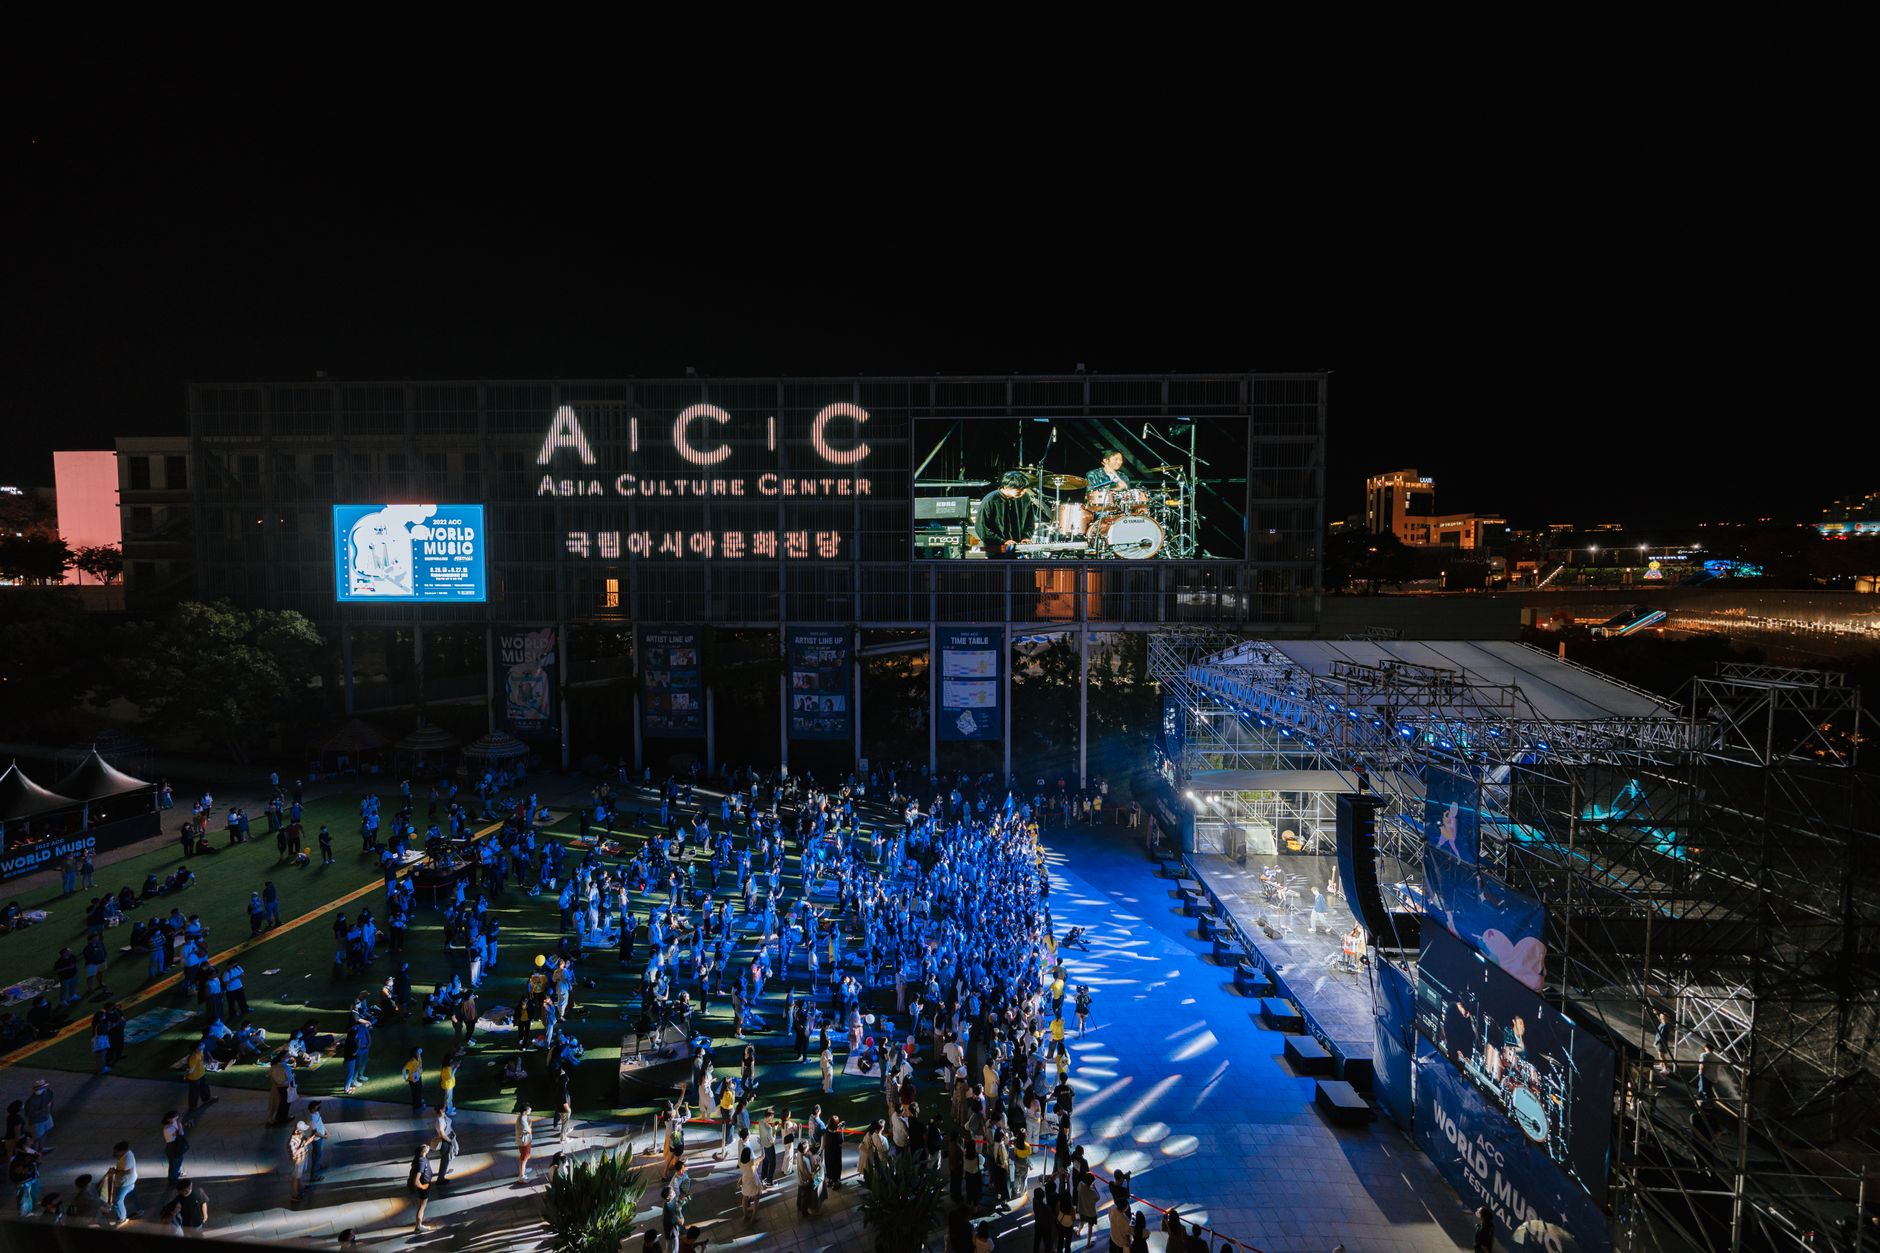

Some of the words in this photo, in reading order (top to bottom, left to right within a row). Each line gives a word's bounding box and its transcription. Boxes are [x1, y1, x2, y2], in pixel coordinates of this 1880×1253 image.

[424, 541, 474, 556] MUSIC
[425, 527, 475, 541] WORLD
[566, 530, 842, 559] 국립아시아문화전당
[0, 849, 51, 873] WORLD
[55, 836, 96, 857] MUSIC
[1433, 1099, 1488, 1179] WORLD
[1476, 1133, 1505, 1168] ACC
[1463, 1166, 1513, 1231] FESTIVAL
